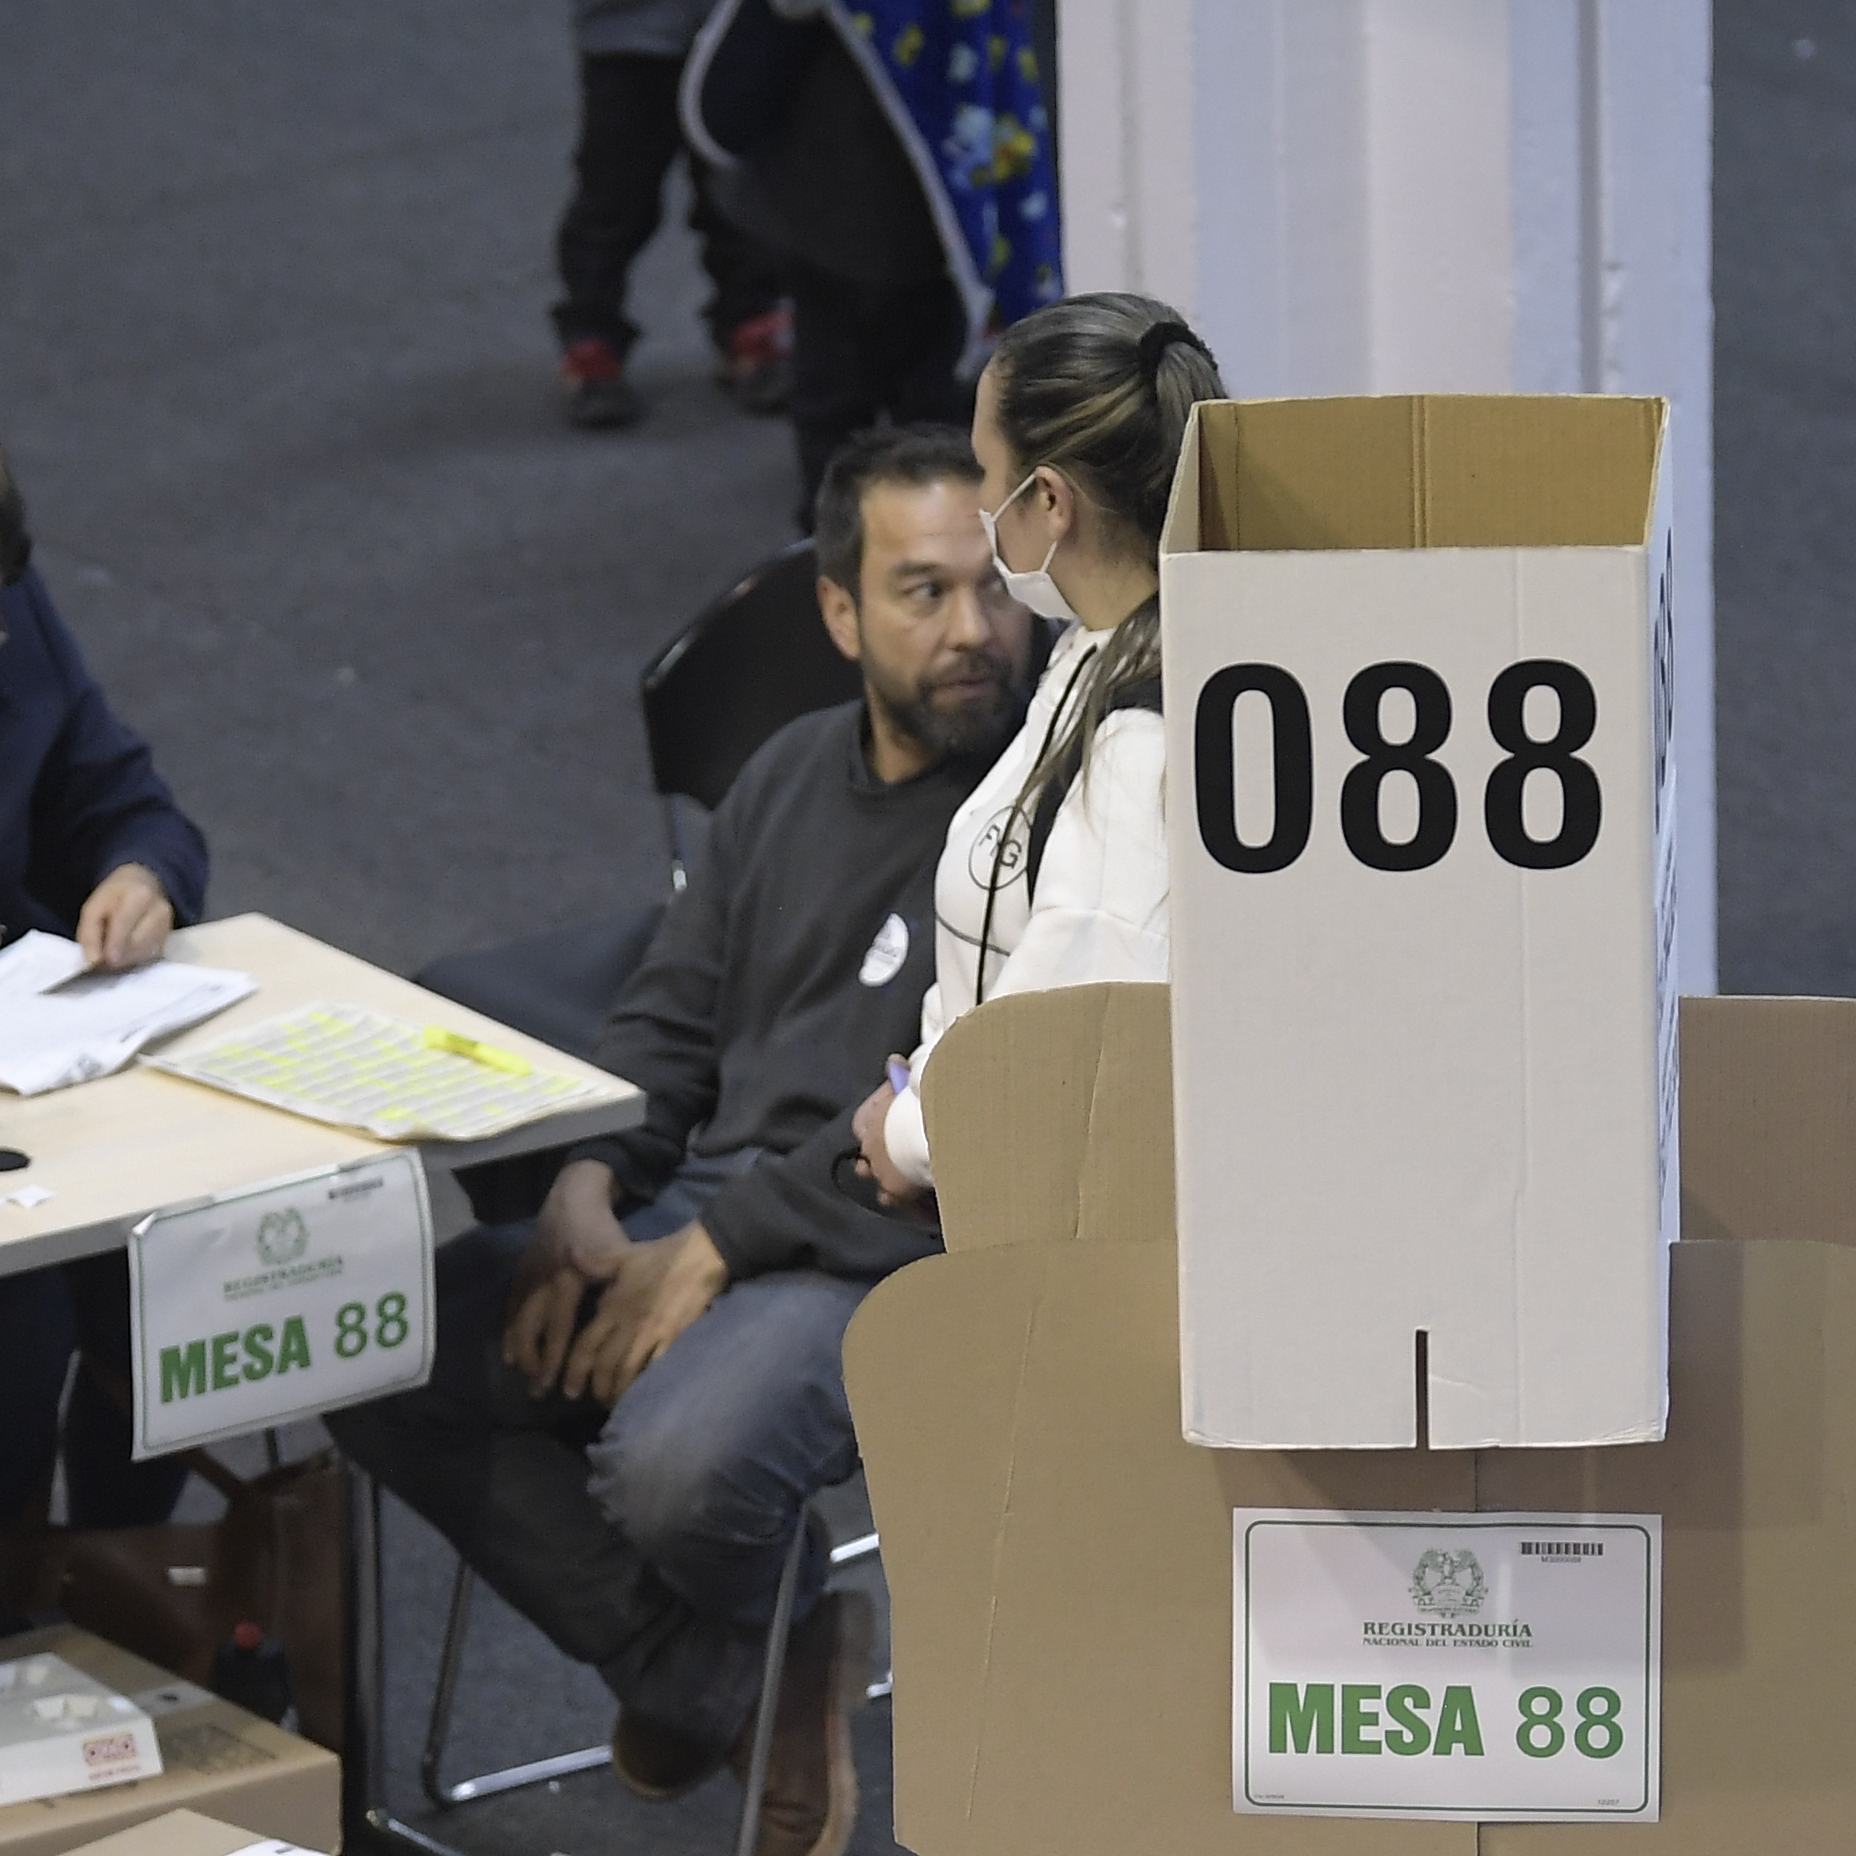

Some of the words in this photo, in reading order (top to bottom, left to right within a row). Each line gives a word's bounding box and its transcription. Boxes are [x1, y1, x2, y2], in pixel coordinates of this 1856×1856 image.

[1194, 658, 1602, 874] 088
[159, 1314, 311, 1404] MESA
[334, 1291, 409, 1358] 88
[1363, 1619, 1532, 1637] REGISTRADURÍA
[1363, 1637, 1420, 1647] NACIONAL
[1426, 1638, 1448, 1647] DEL
[1453, 1639, 1499, 1648] ESTADO
[1502, 1639, 1533, 1648] CIVIL
[1268, 1682, 1485, 1757] MESA
[1515, 1685, 1625, 1760] 88
